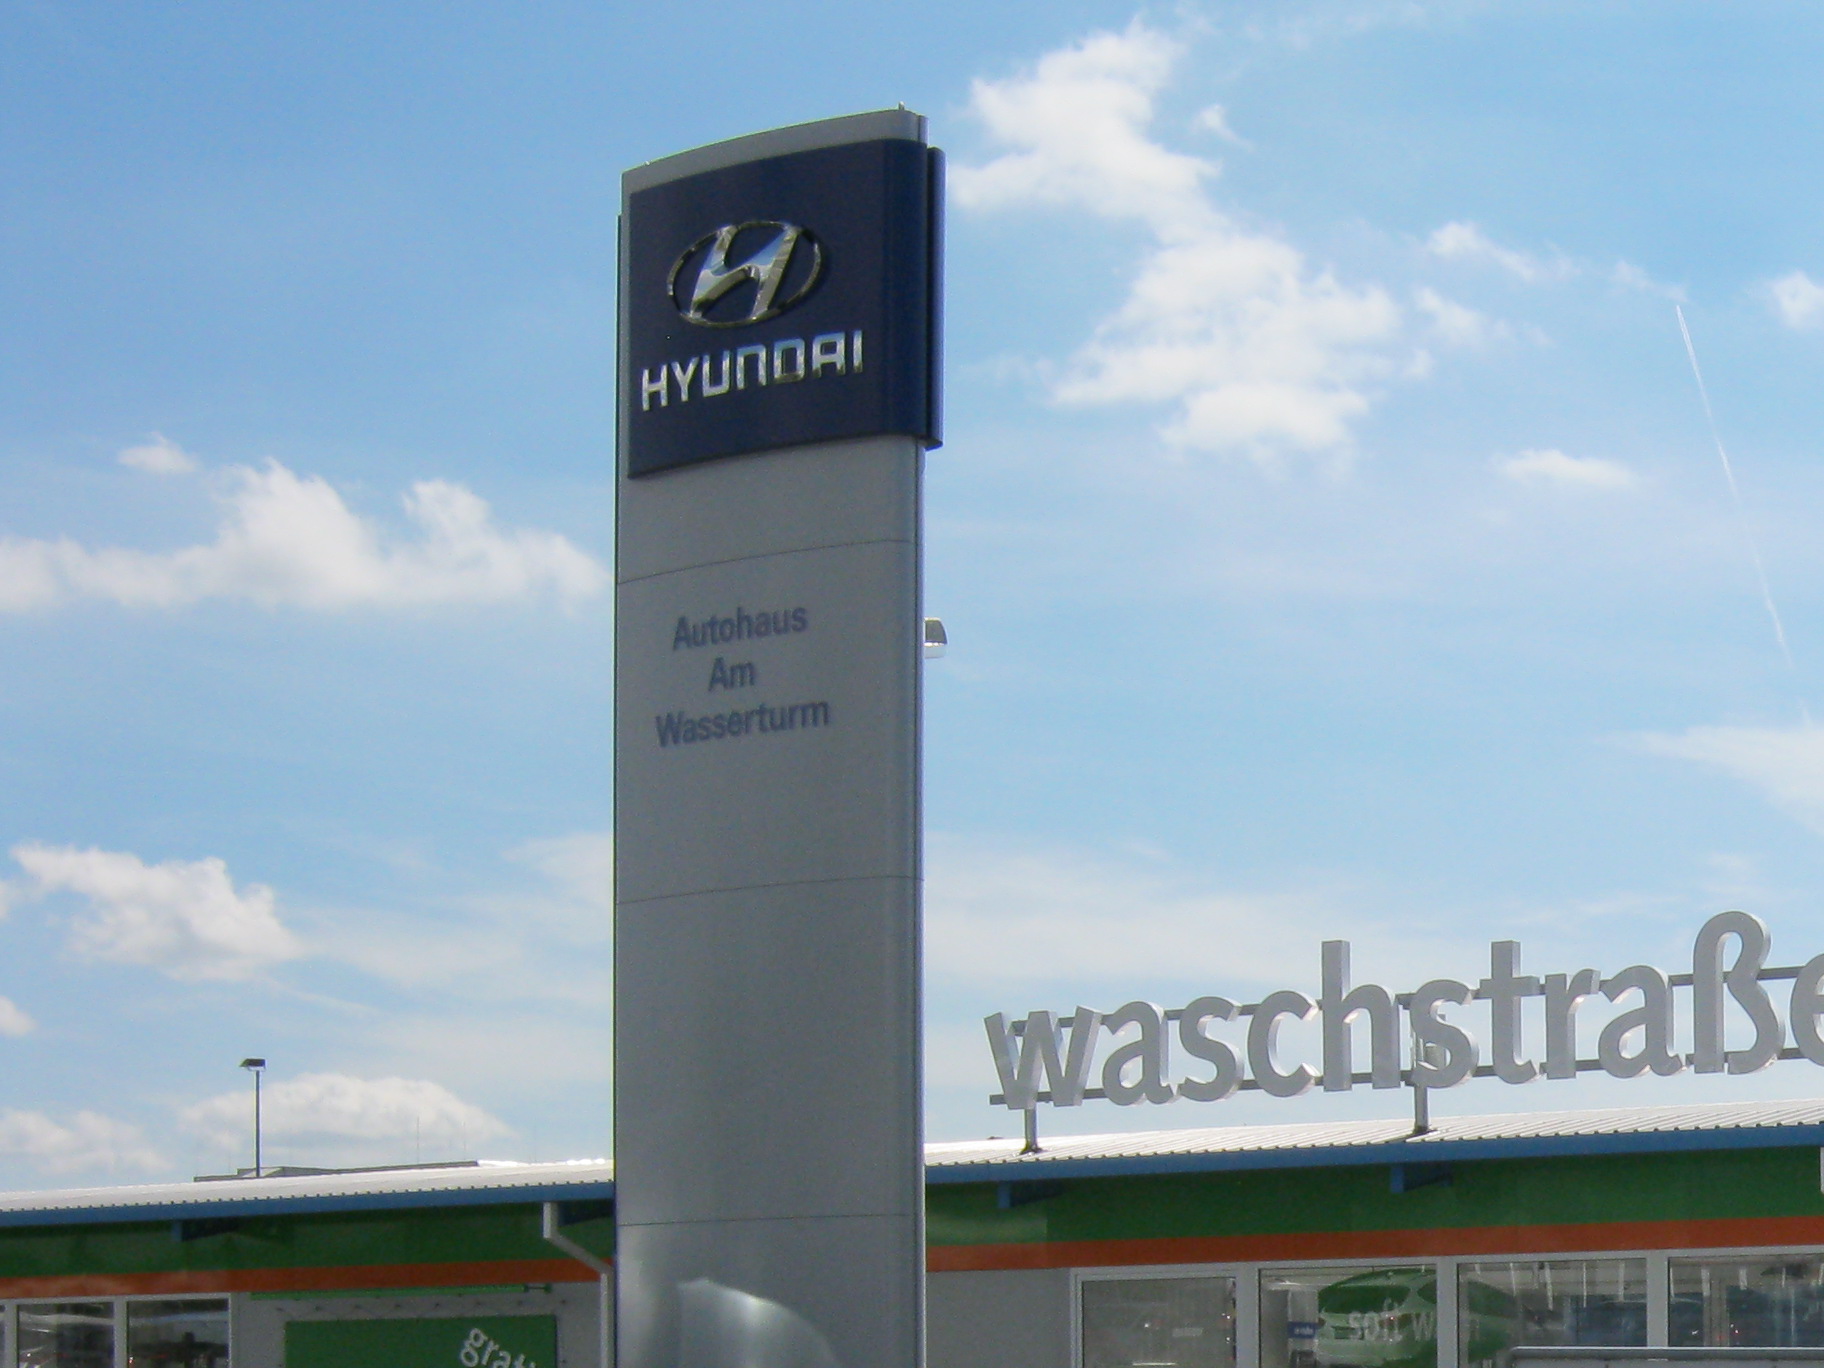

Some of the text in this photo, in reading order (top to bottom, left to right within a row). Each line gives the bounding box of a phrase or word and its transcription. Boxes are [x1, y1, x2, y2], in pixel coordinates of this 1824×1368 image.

[641, 330, 863, 411] HYUNDAI
[672, 604, 808, 651] Autohaus
[708, 656, 755, 693] Am
[655, 699, 829, 748] Wasserturm
